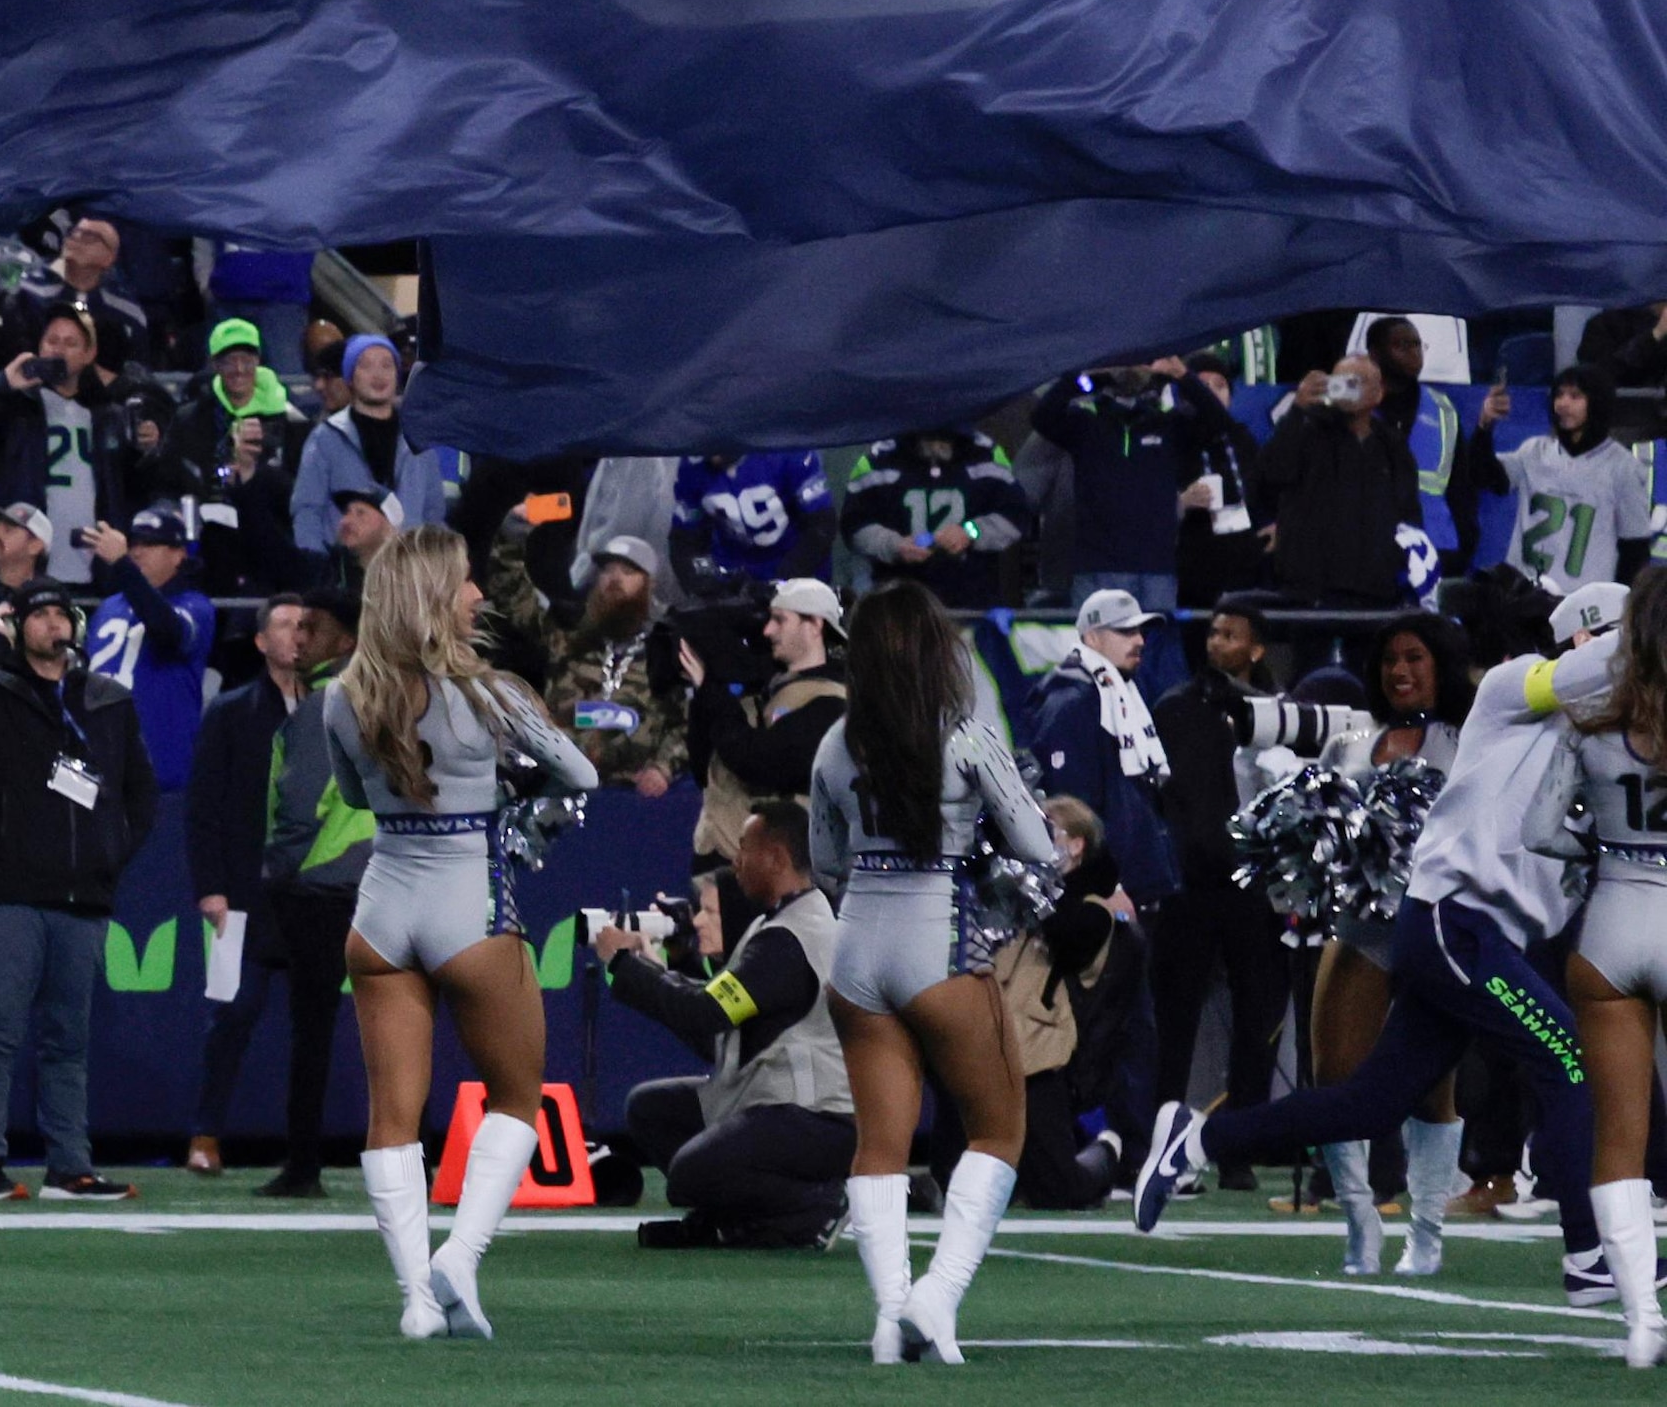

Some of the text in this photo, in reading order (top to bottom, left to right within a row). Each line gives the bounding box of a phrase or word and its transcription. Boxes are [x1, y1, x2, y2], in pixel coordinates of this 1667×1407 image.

[903, 488, 967, 539] 12
[1521, 494, 1596, 578] 21
[88, 617, 147, 690] 21
[1579, 606, 1602, 628] 12
[1484, 976, 1585, 1085] SEAHAWKS
